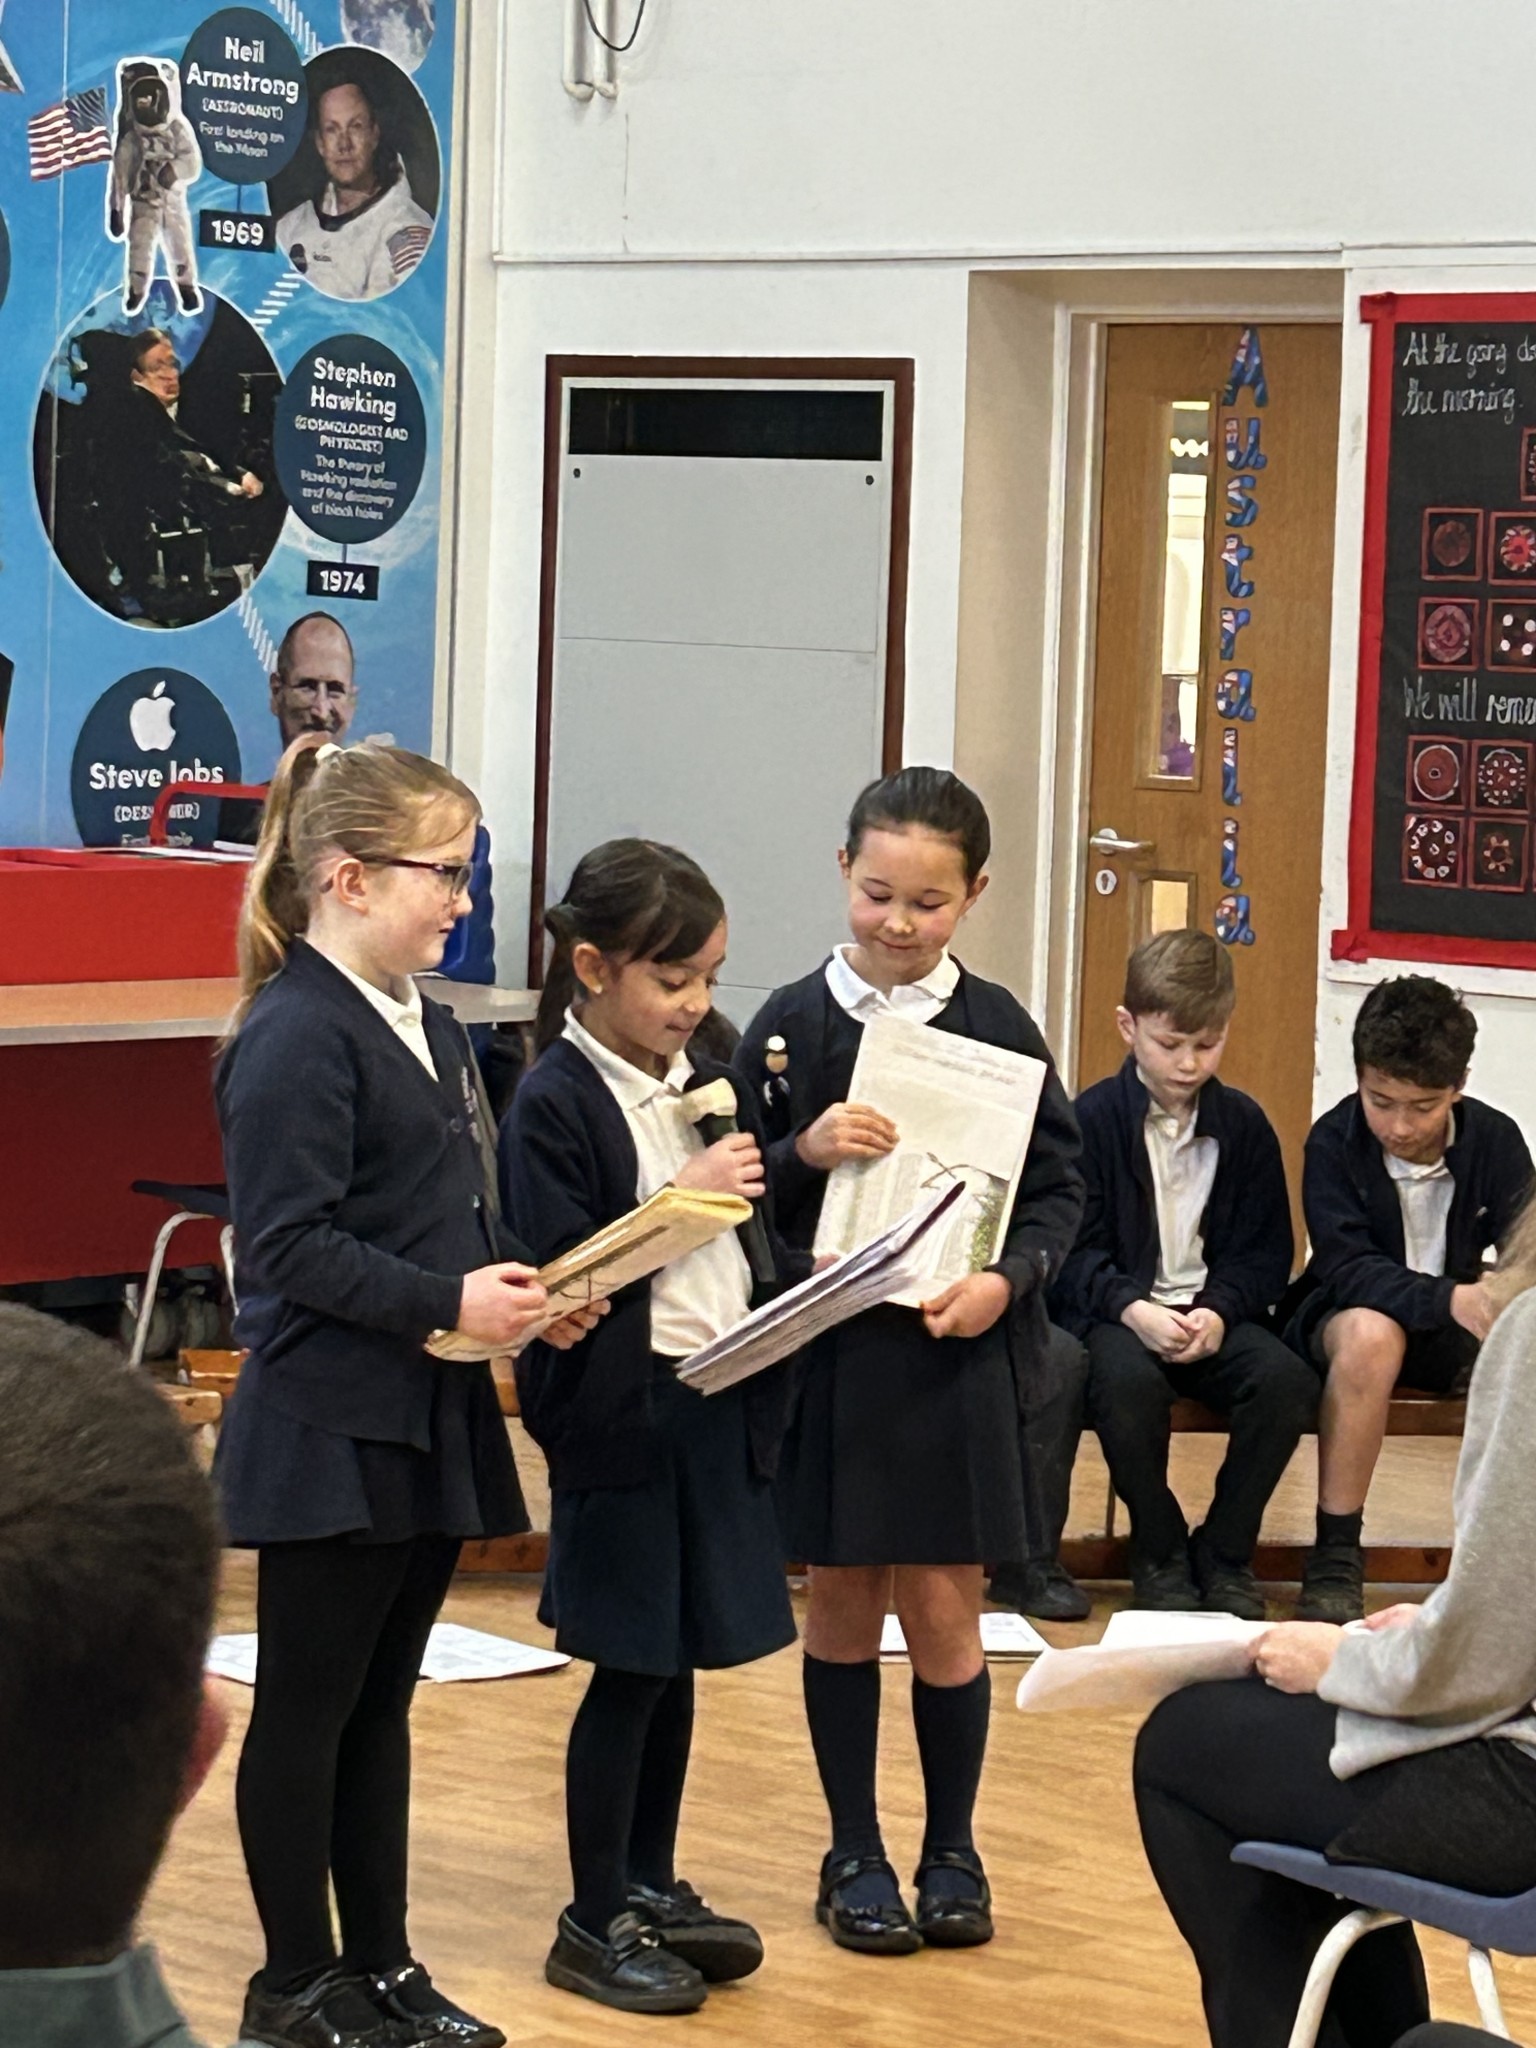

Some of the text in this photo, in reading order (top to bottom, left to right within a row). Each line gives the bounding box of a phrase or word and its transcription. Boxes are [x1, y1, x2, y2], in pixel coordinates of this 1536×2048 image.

[225, 36, 265, 63] Neil
[186, 62, 299, 104] Armstrong
[211, 220, 264, 246] 1969
[1403, 331, 1429, 367] At
[1433, 332, 1462, 365] the
[313, 357, 396, 388] Stephen
[310, 385, 397, 422] Hawking
[1401, 377, 1438, 415] the
[384, 427, 409, 441] AND
[319, 569, 366, 594] 1974
[1215, 324, 1269, 946] Australia
[1438, 676, 1477, 722] will
[89, 758, 224, 790] Steve Jobs
